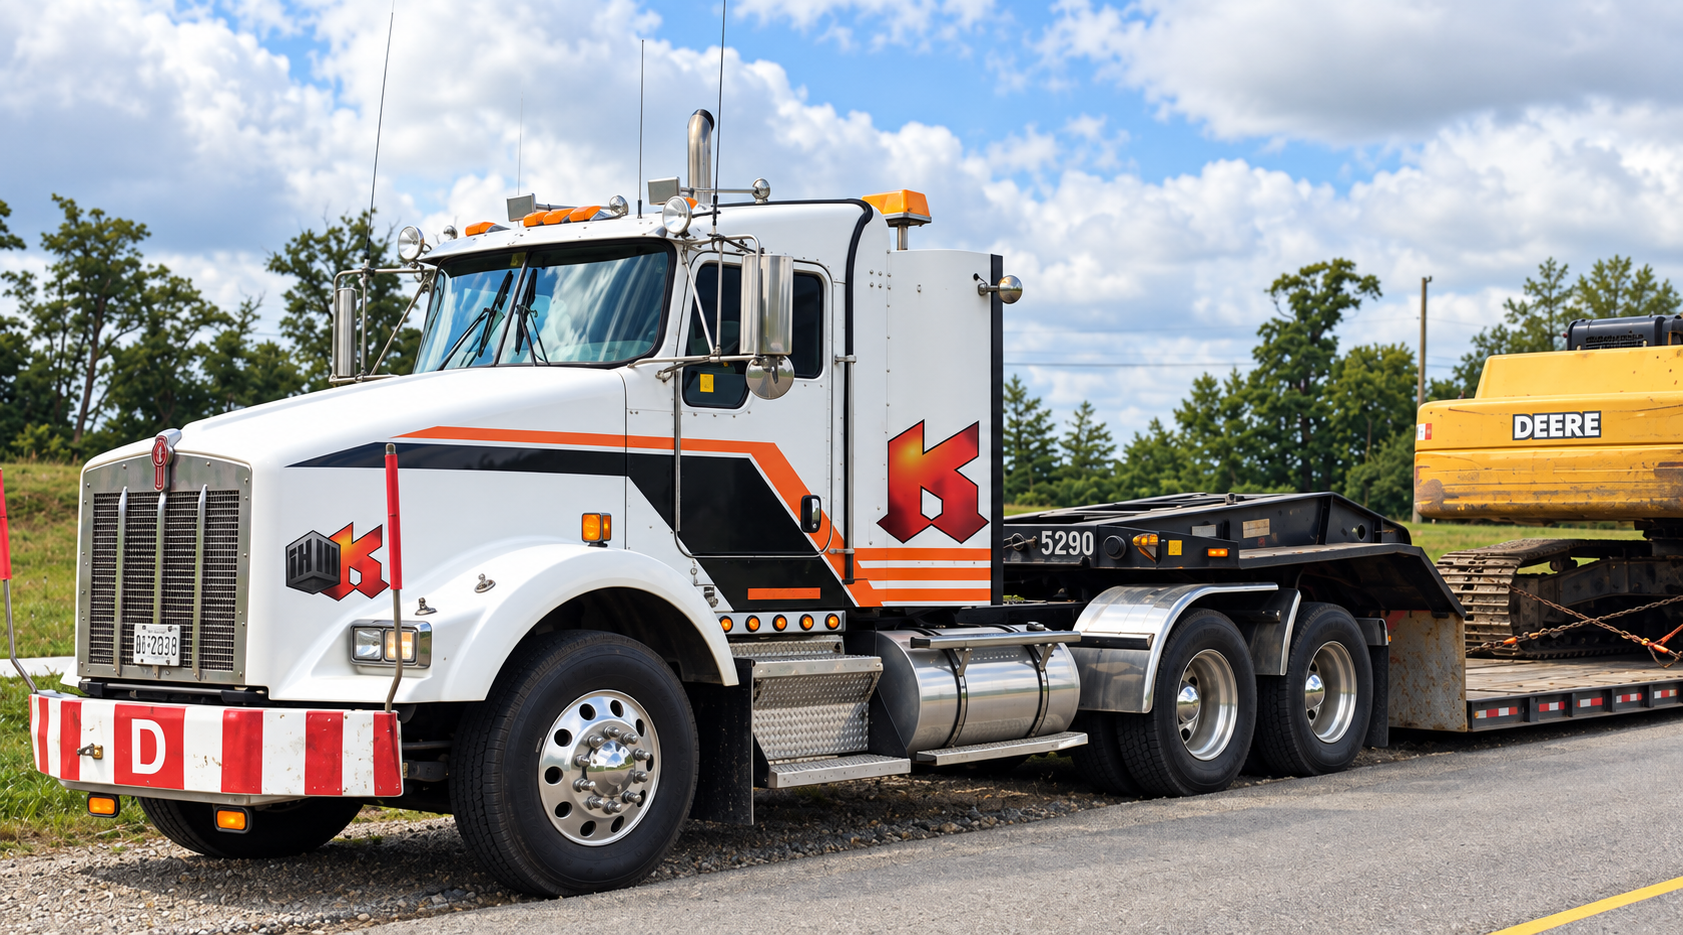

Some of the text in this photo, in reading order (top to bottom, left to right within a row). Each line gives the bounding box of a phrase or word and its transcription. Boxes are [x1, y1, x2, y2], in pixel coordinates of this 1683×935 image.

[1513, 411, 1601, 440] DEERE
[1041, 530, 1094, 556] 5290
[131, 718, 166, 775] D
